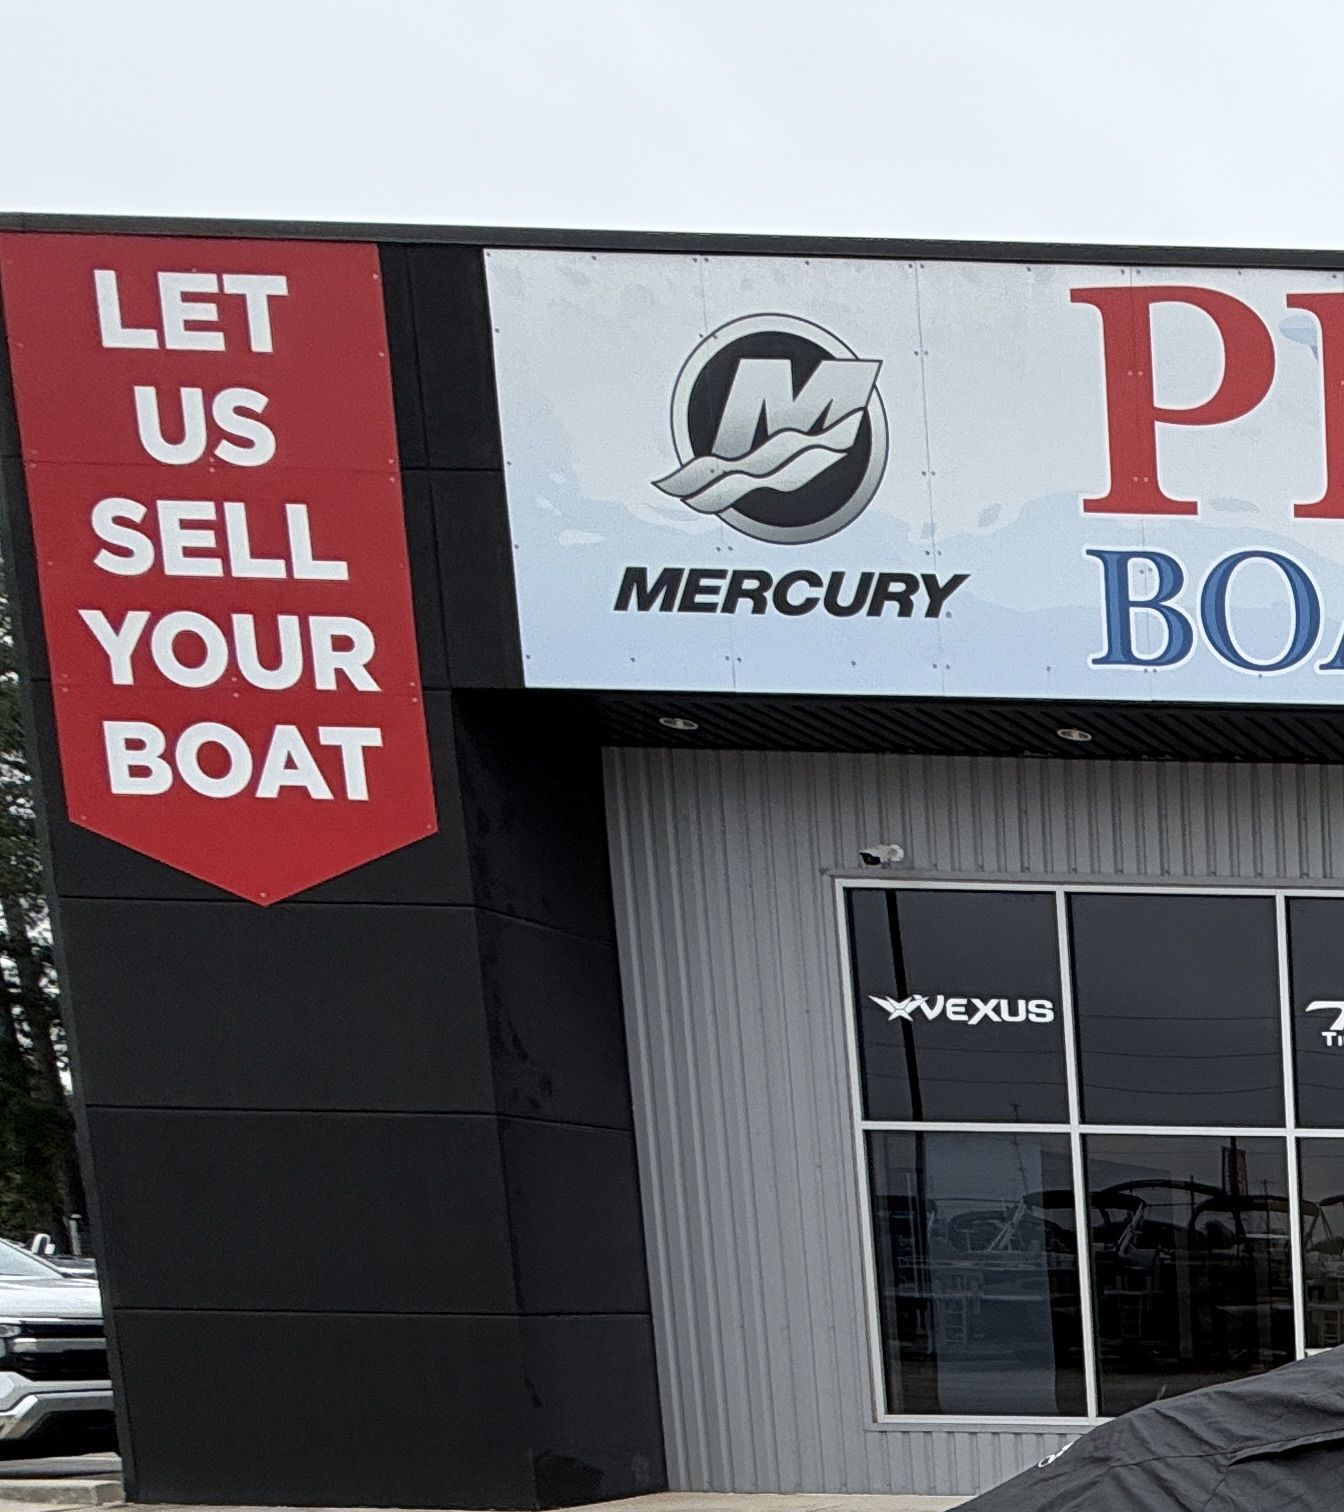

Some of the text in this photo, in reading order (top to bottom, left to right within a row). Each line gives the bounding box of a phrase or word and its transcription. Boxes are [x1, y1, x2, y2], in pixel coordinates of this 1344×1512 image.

[93, 269, 289, 353] LET
[133, 386, 277, 467] US
[91, 497, 349, 581] SELL
[613, 567, 971, 618] MERCURY
[82, 610, 382, 692] YOUR
[103, 720, 383, 801] BOAT
[913, 994, 1055, 1025] VEXUS
